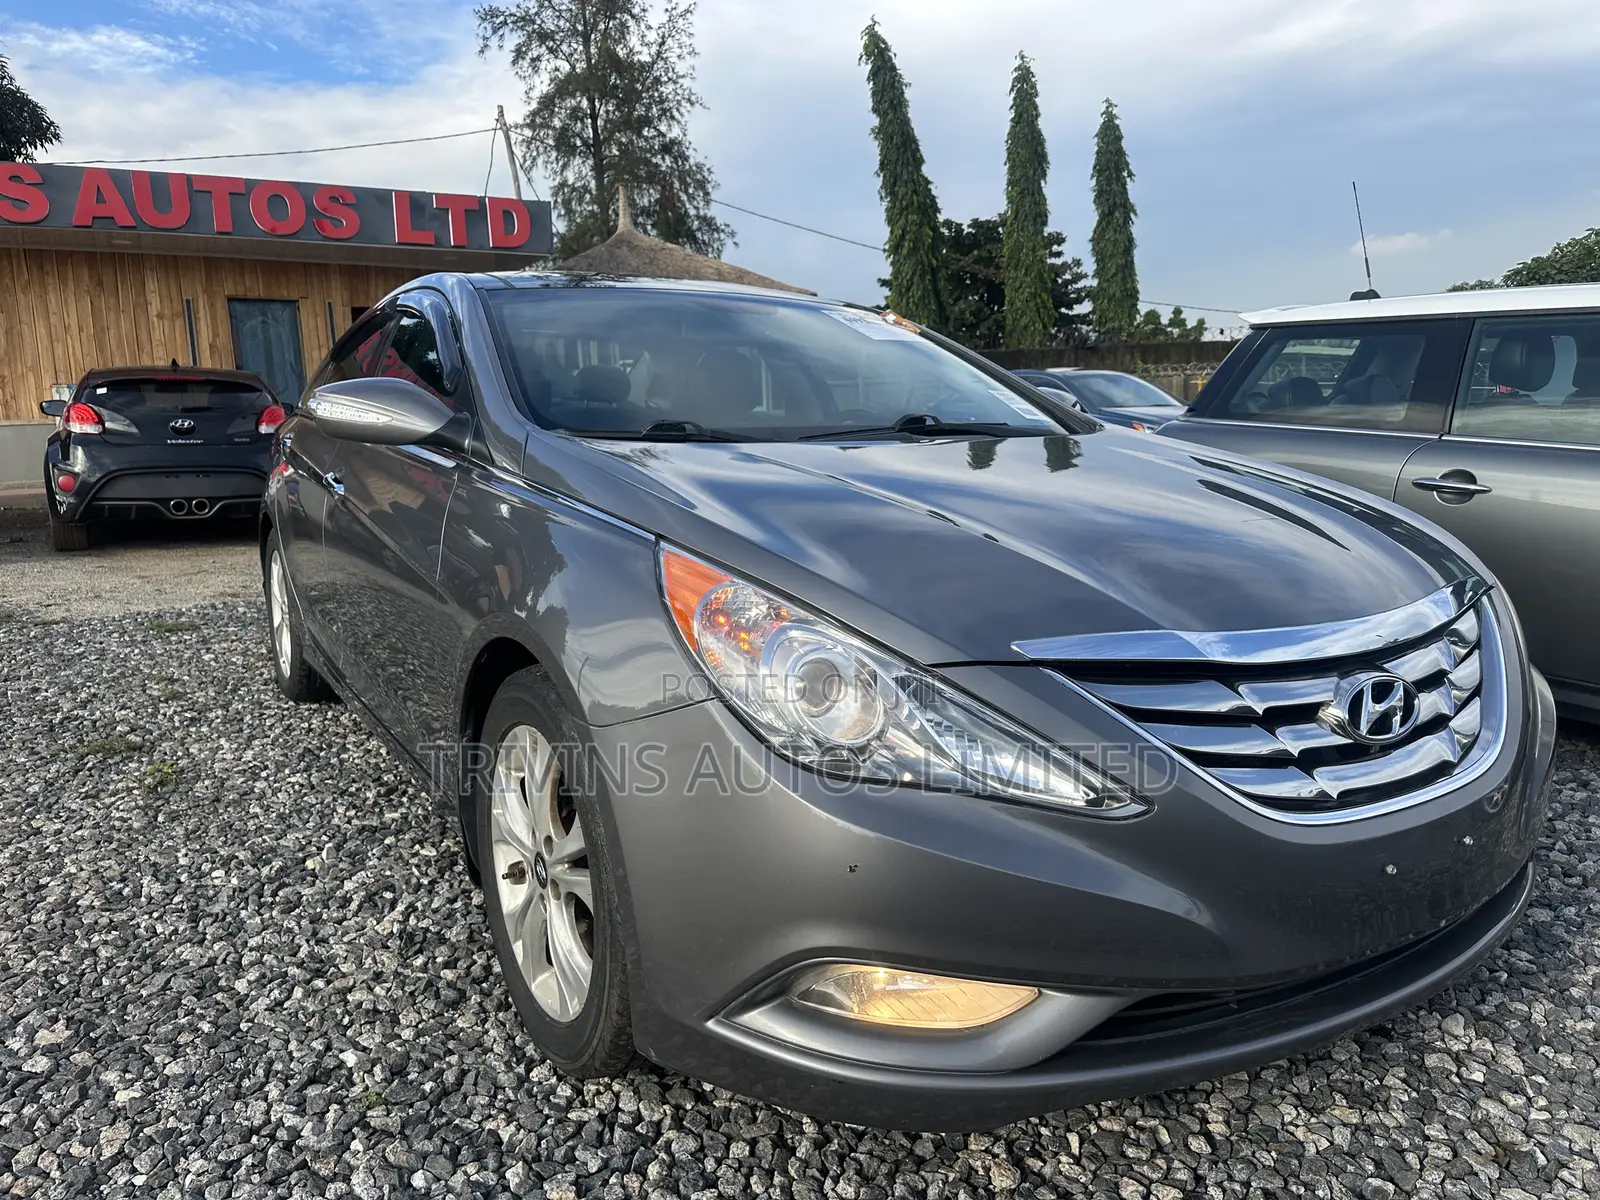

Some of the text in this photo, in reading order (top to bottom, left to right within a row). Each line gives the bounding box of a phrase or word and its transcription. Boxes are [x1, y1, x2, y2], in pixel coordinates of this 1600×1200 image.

[0, 163, 532, 249] S AUTOS LTD
